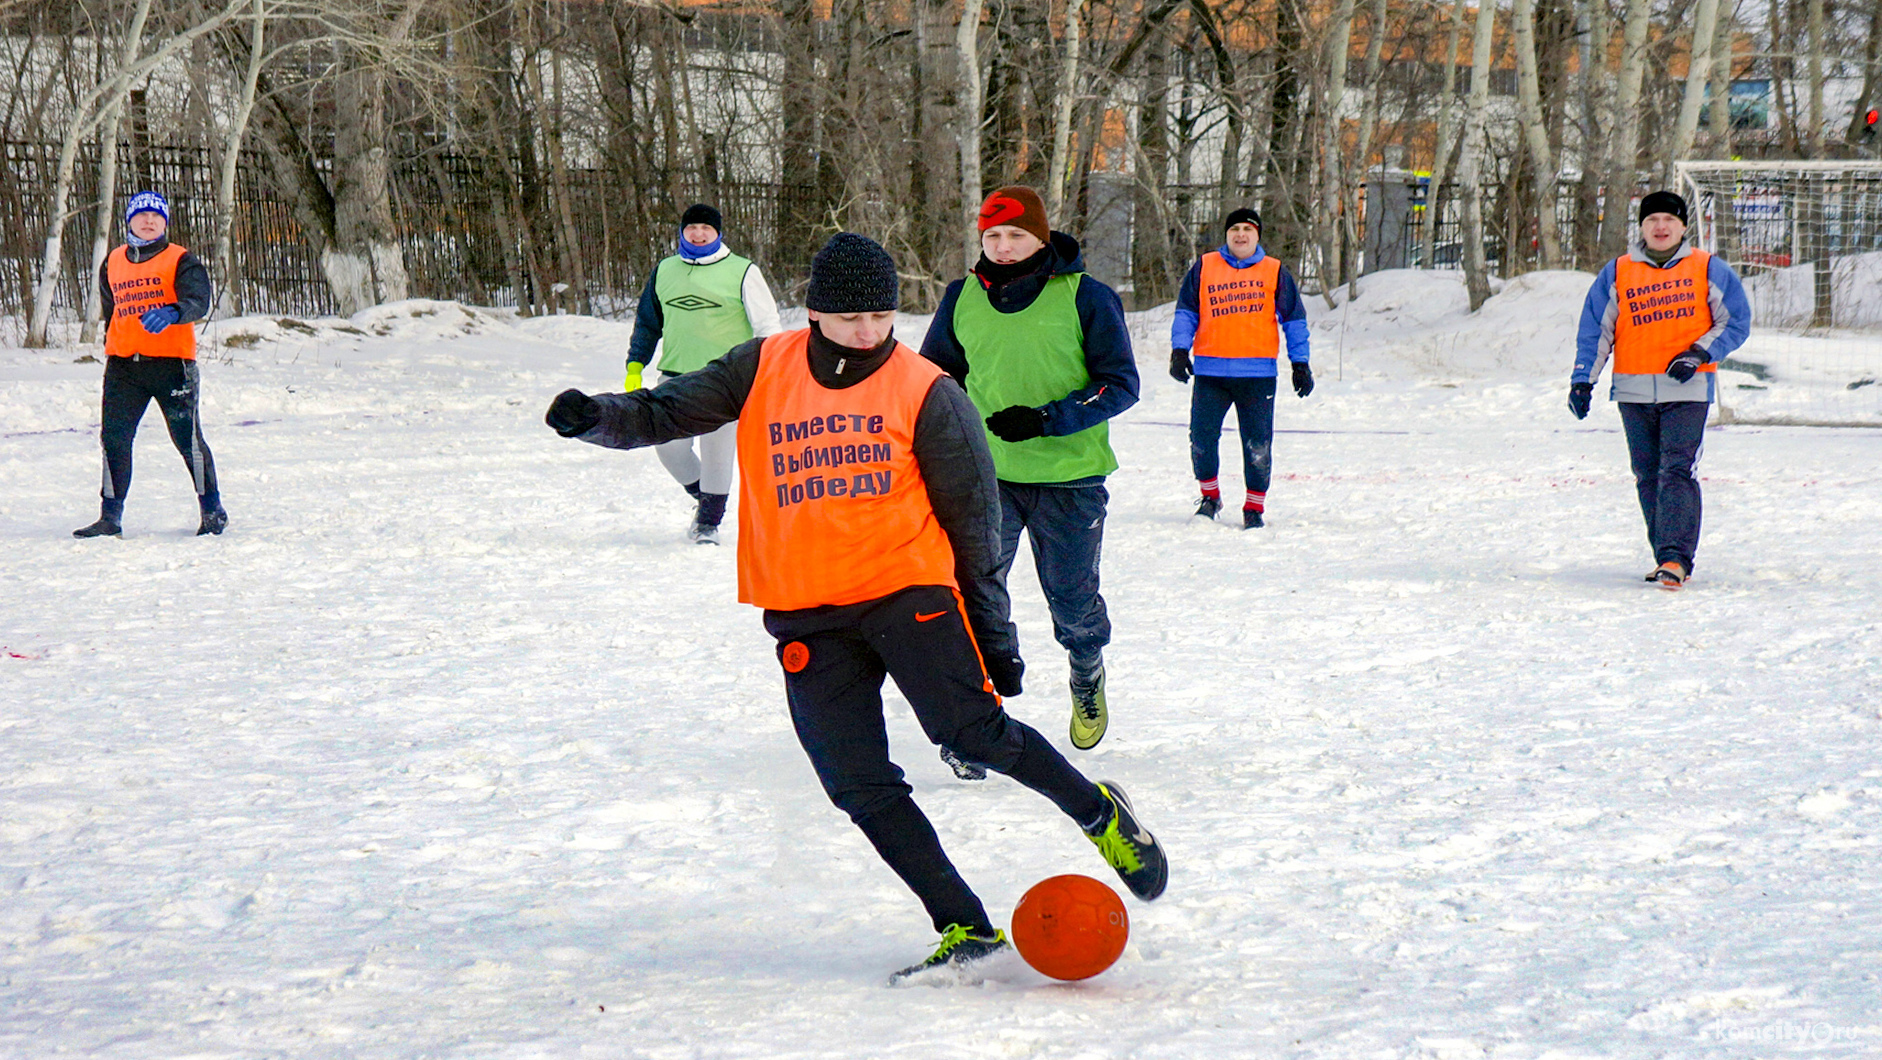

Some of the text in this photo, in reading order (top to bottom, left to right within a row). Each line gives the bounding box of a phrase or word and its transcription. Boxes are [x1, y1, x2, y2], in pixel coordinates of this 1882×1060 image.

[1208, 280, 1264, 294] Вместе
[1626, 278, 1693, 299] Вместе
[1209, 292, 1266, 306] Выбираем
[1629, 292, 1695, 313] Выбираем
[1212, 303, 1264, 318] Победу
[1632, 306, 1695, 326] Победу
[768, 414, 884, 446] Вместе
[772, 442, 892, 477] Выбираем
[776, 470, 892, 508] Победу
